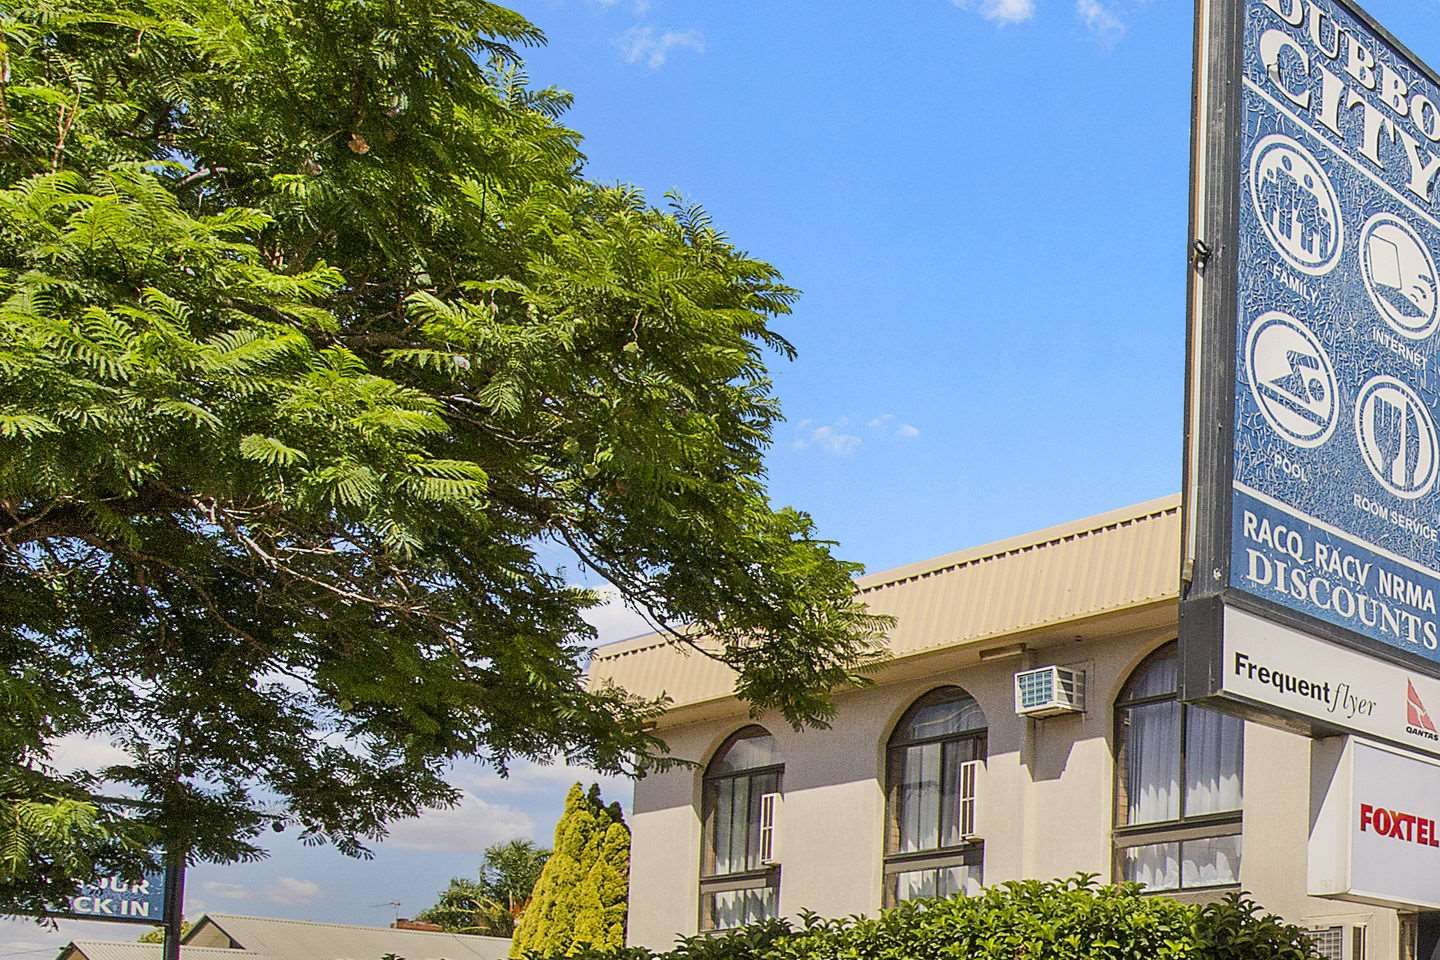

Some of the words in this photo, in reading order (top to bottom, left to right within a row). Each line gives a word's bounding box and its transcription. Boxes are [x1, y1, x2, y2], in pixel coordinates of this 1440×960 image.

[1271, 266, 1319, 302] FAMILY
[1372, 327, 1428, 370] INTERNET
[1274, 455, 1309, 482] POOL
[1353, 494, 1389, 521] ROOM
[1391, 511, 1438, 542] SERVICE
[1243, 511, 1312, 565] RACQ
[1315, 541, 1372, 586] RACV
[1379, 568, 1436, 614] NRMA
[1246, 548, 1438, 650] DISCOUNTS
[1235, 651, 1330, 703] Frequent
[1328, 683, 1377, 718] flyer
[1406, 726, 1439, 742] QANTAS
[1360, 803, 1440, 848] FOXTEL
[121, 900, 149, 917] IN
